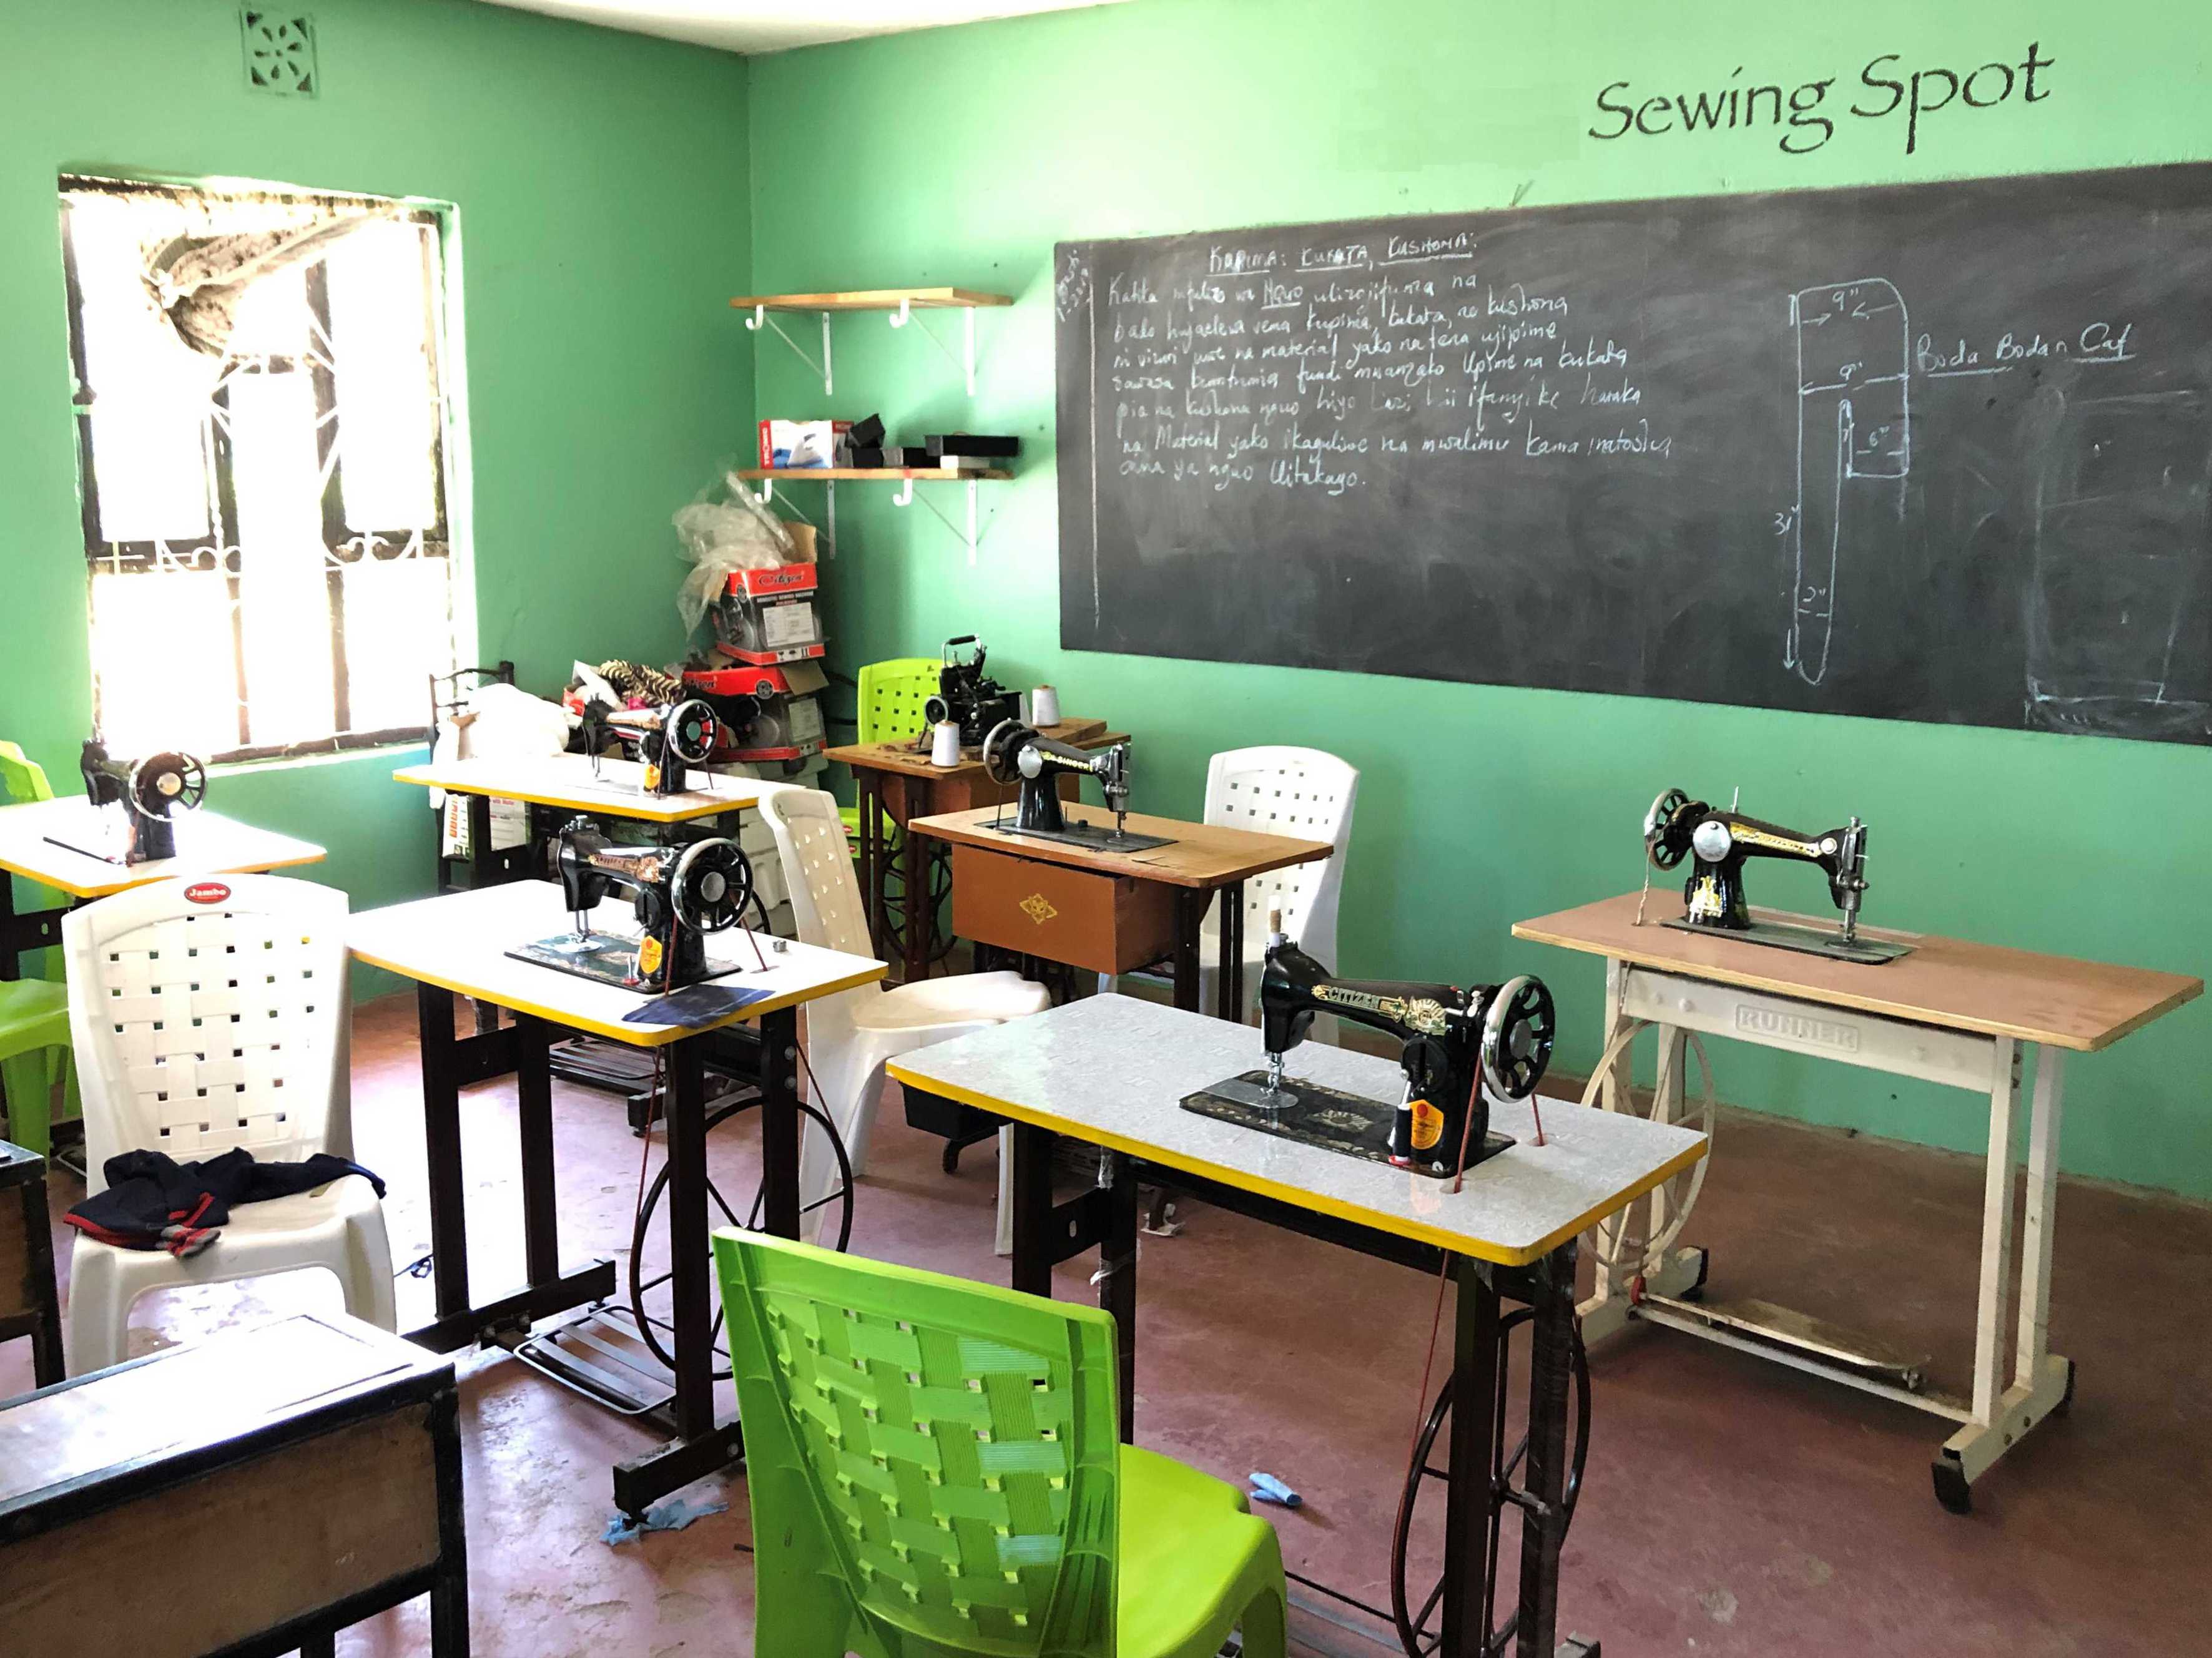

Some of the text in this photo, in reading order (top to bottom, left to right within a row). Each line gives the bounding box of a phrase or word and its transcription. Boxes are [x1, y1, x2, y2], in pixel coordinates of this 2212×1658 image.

[1588, 41, 2055, 154] Sewing Spot
[1453, 275, 1476, 288] na
[1523, 356, 1543, 368] na
[1328, 986, 1380, 1009] CITIZEN
[1739, 1007, 1856, 1049] RUNNER
